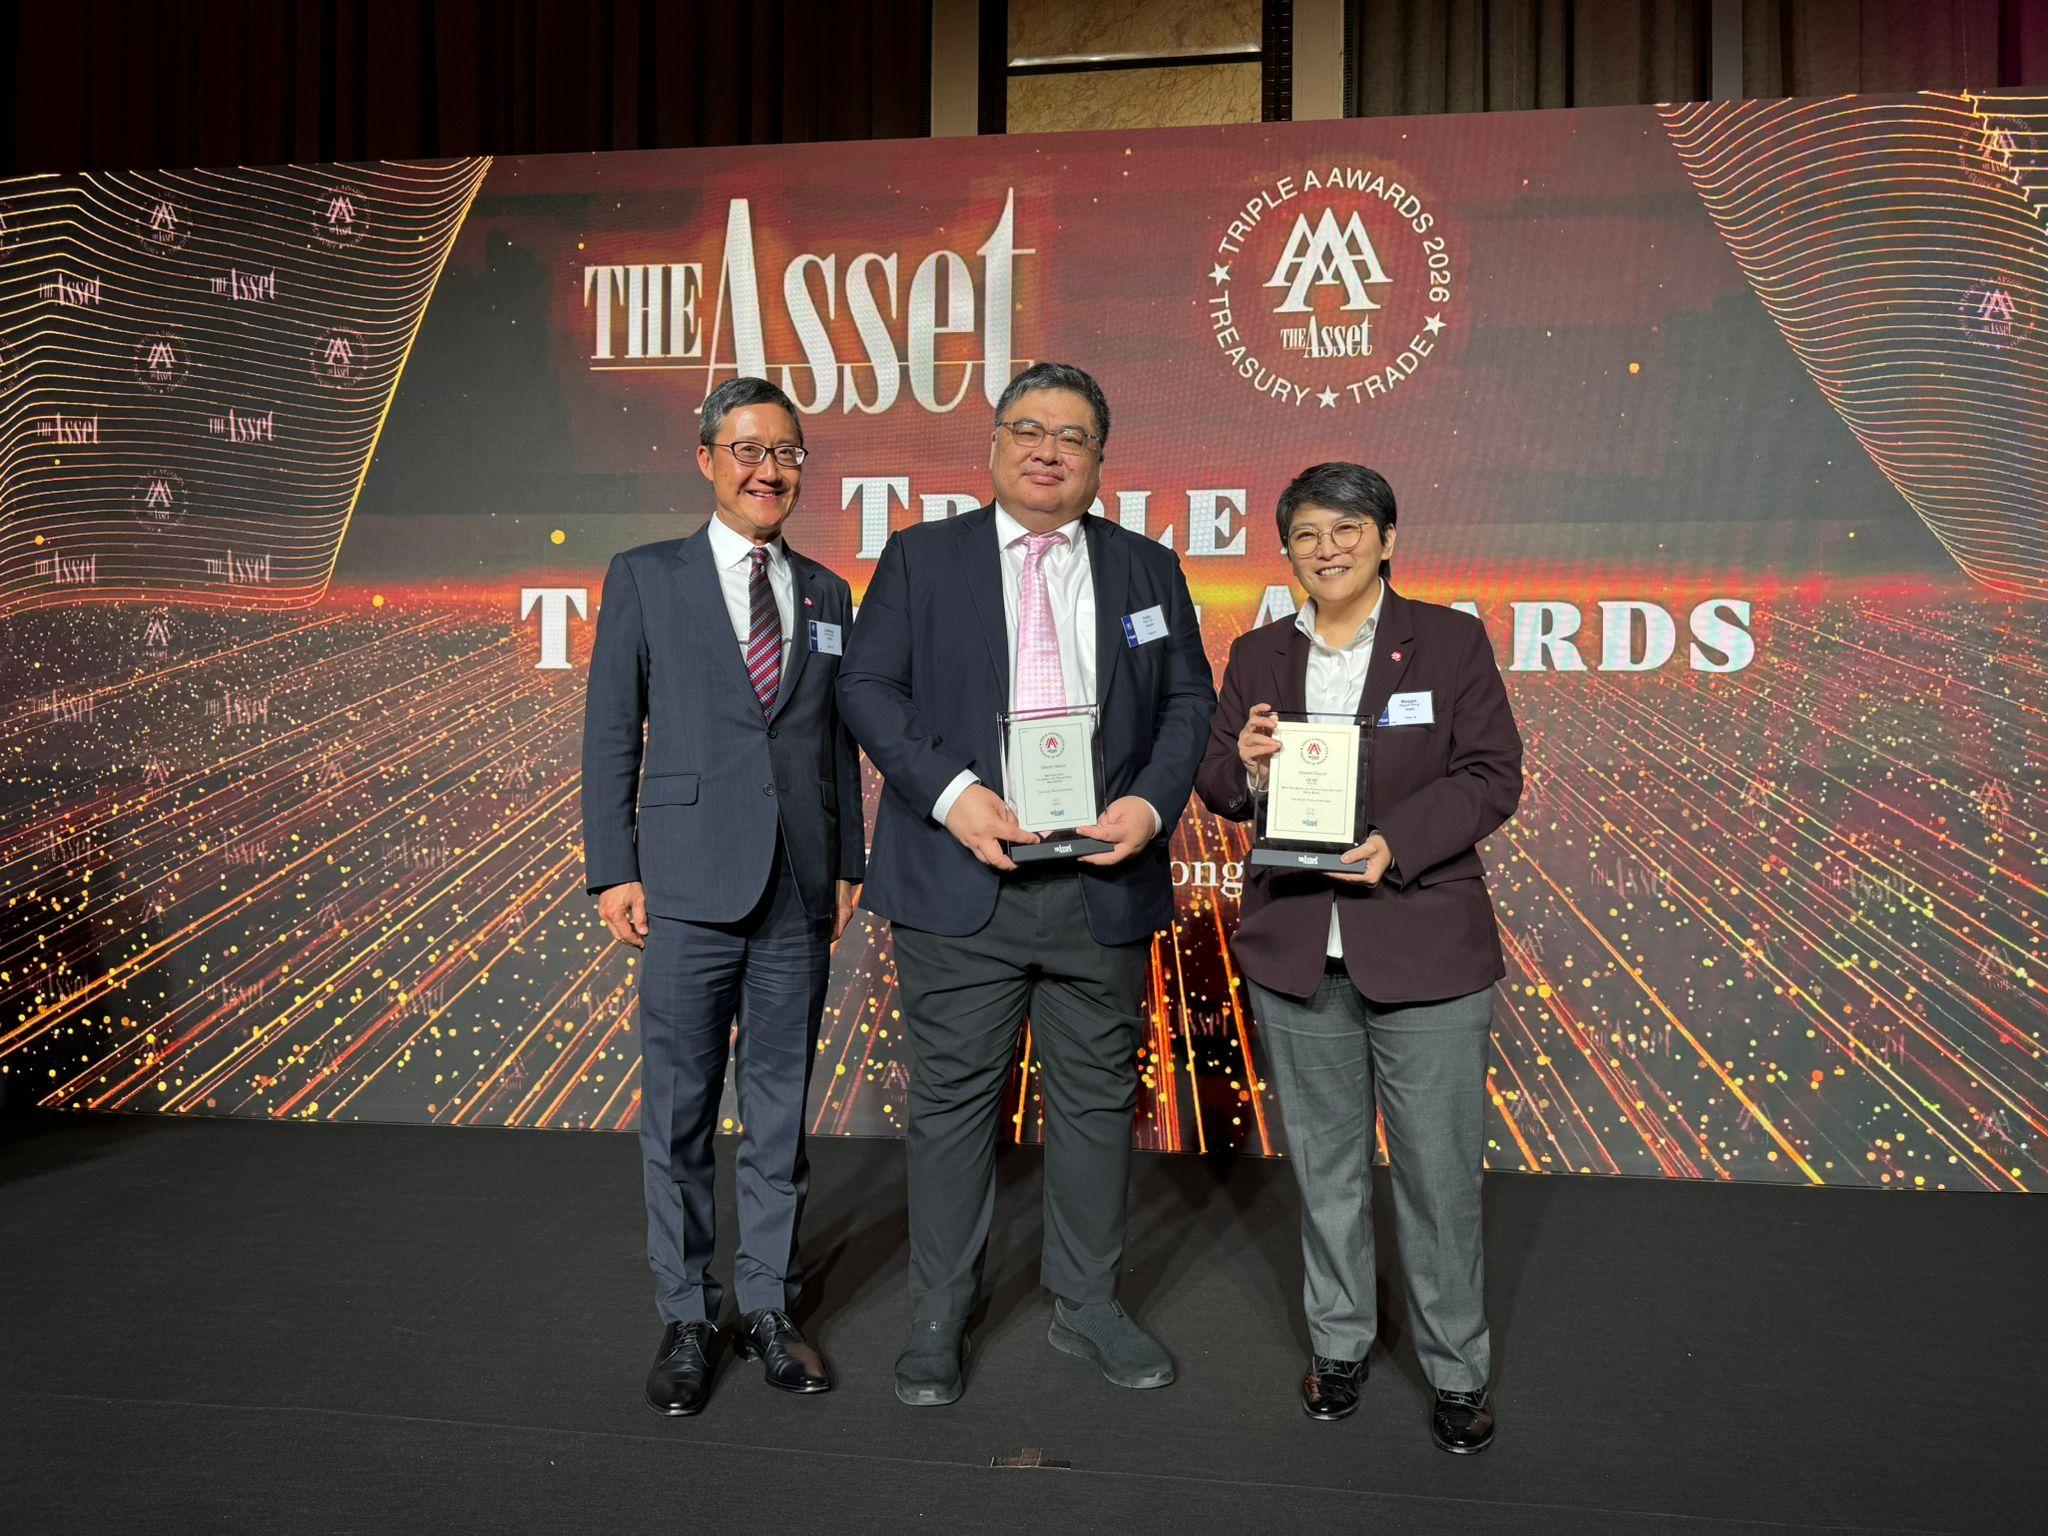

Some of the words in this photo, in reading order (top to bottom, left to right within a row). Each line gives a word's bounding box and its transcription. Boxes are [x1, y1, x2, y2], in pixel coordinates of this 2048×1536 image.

[1217, 175, 1298, 257] TRIPLE
[1303, 170, 1323, 192] A
[1326, 167, 1435, 235] AWARDS
[1422, 236, 1452, 304] 2026
[583, 262, 703, 361] THE
[694, 187, 1036, 416] Asset
[1208, 290, 1311, 408] TREASURY
[1303, 314, 1373, 359] Asset
[1346, 334, 1436, 405] TRADE
